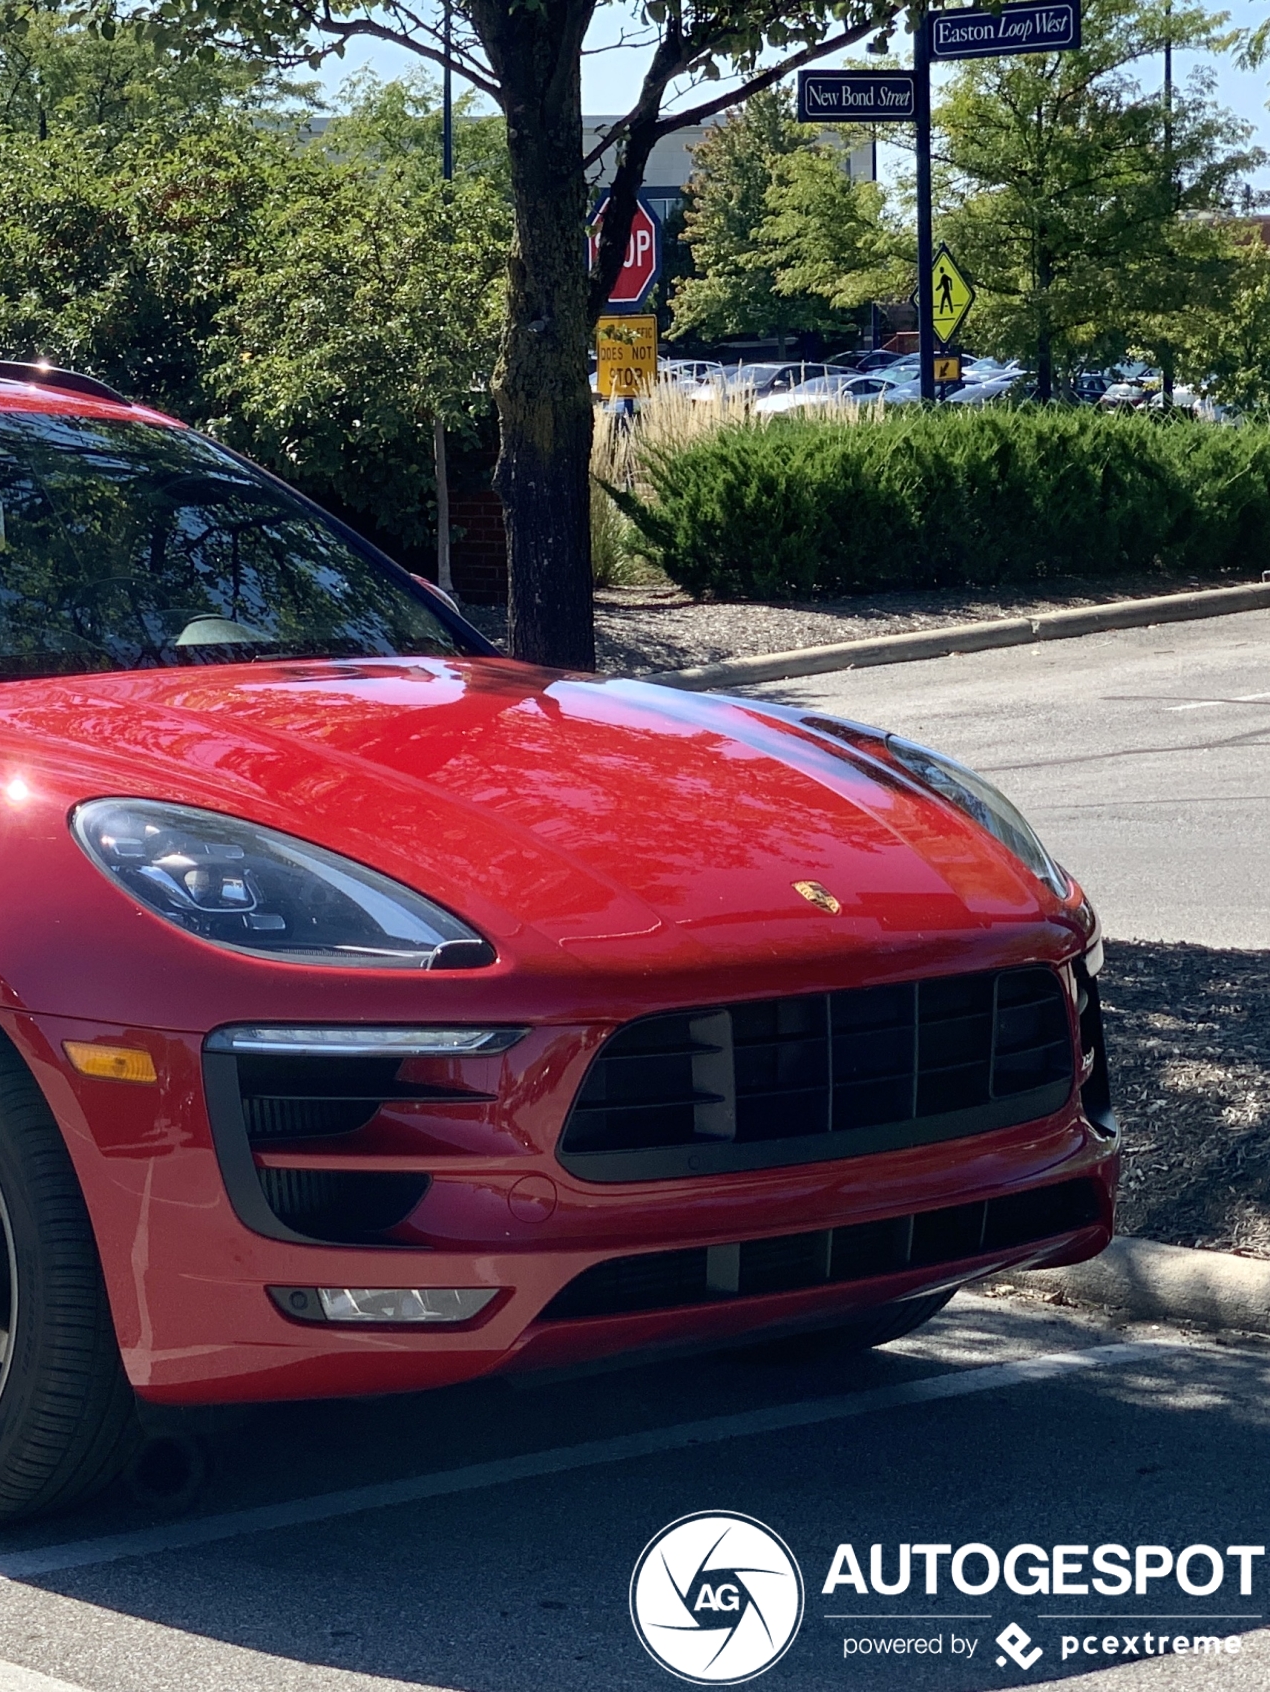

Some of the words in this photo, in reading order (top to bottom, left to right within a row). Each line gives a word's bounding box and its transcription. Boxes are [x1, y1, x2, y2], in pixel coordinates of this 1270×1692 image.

[938, 22, 995, 44] Easton
[997, 16, 1033, 41] Loop
[1035, 12, 1069, 34] West
[809, 85, 839, 107] New
[841, 85, 875, 106] Bond
[877, 86, 911, 107] Street
[601, 347, 623, 360] DOES
[632, 346, 652, 360] NOT
